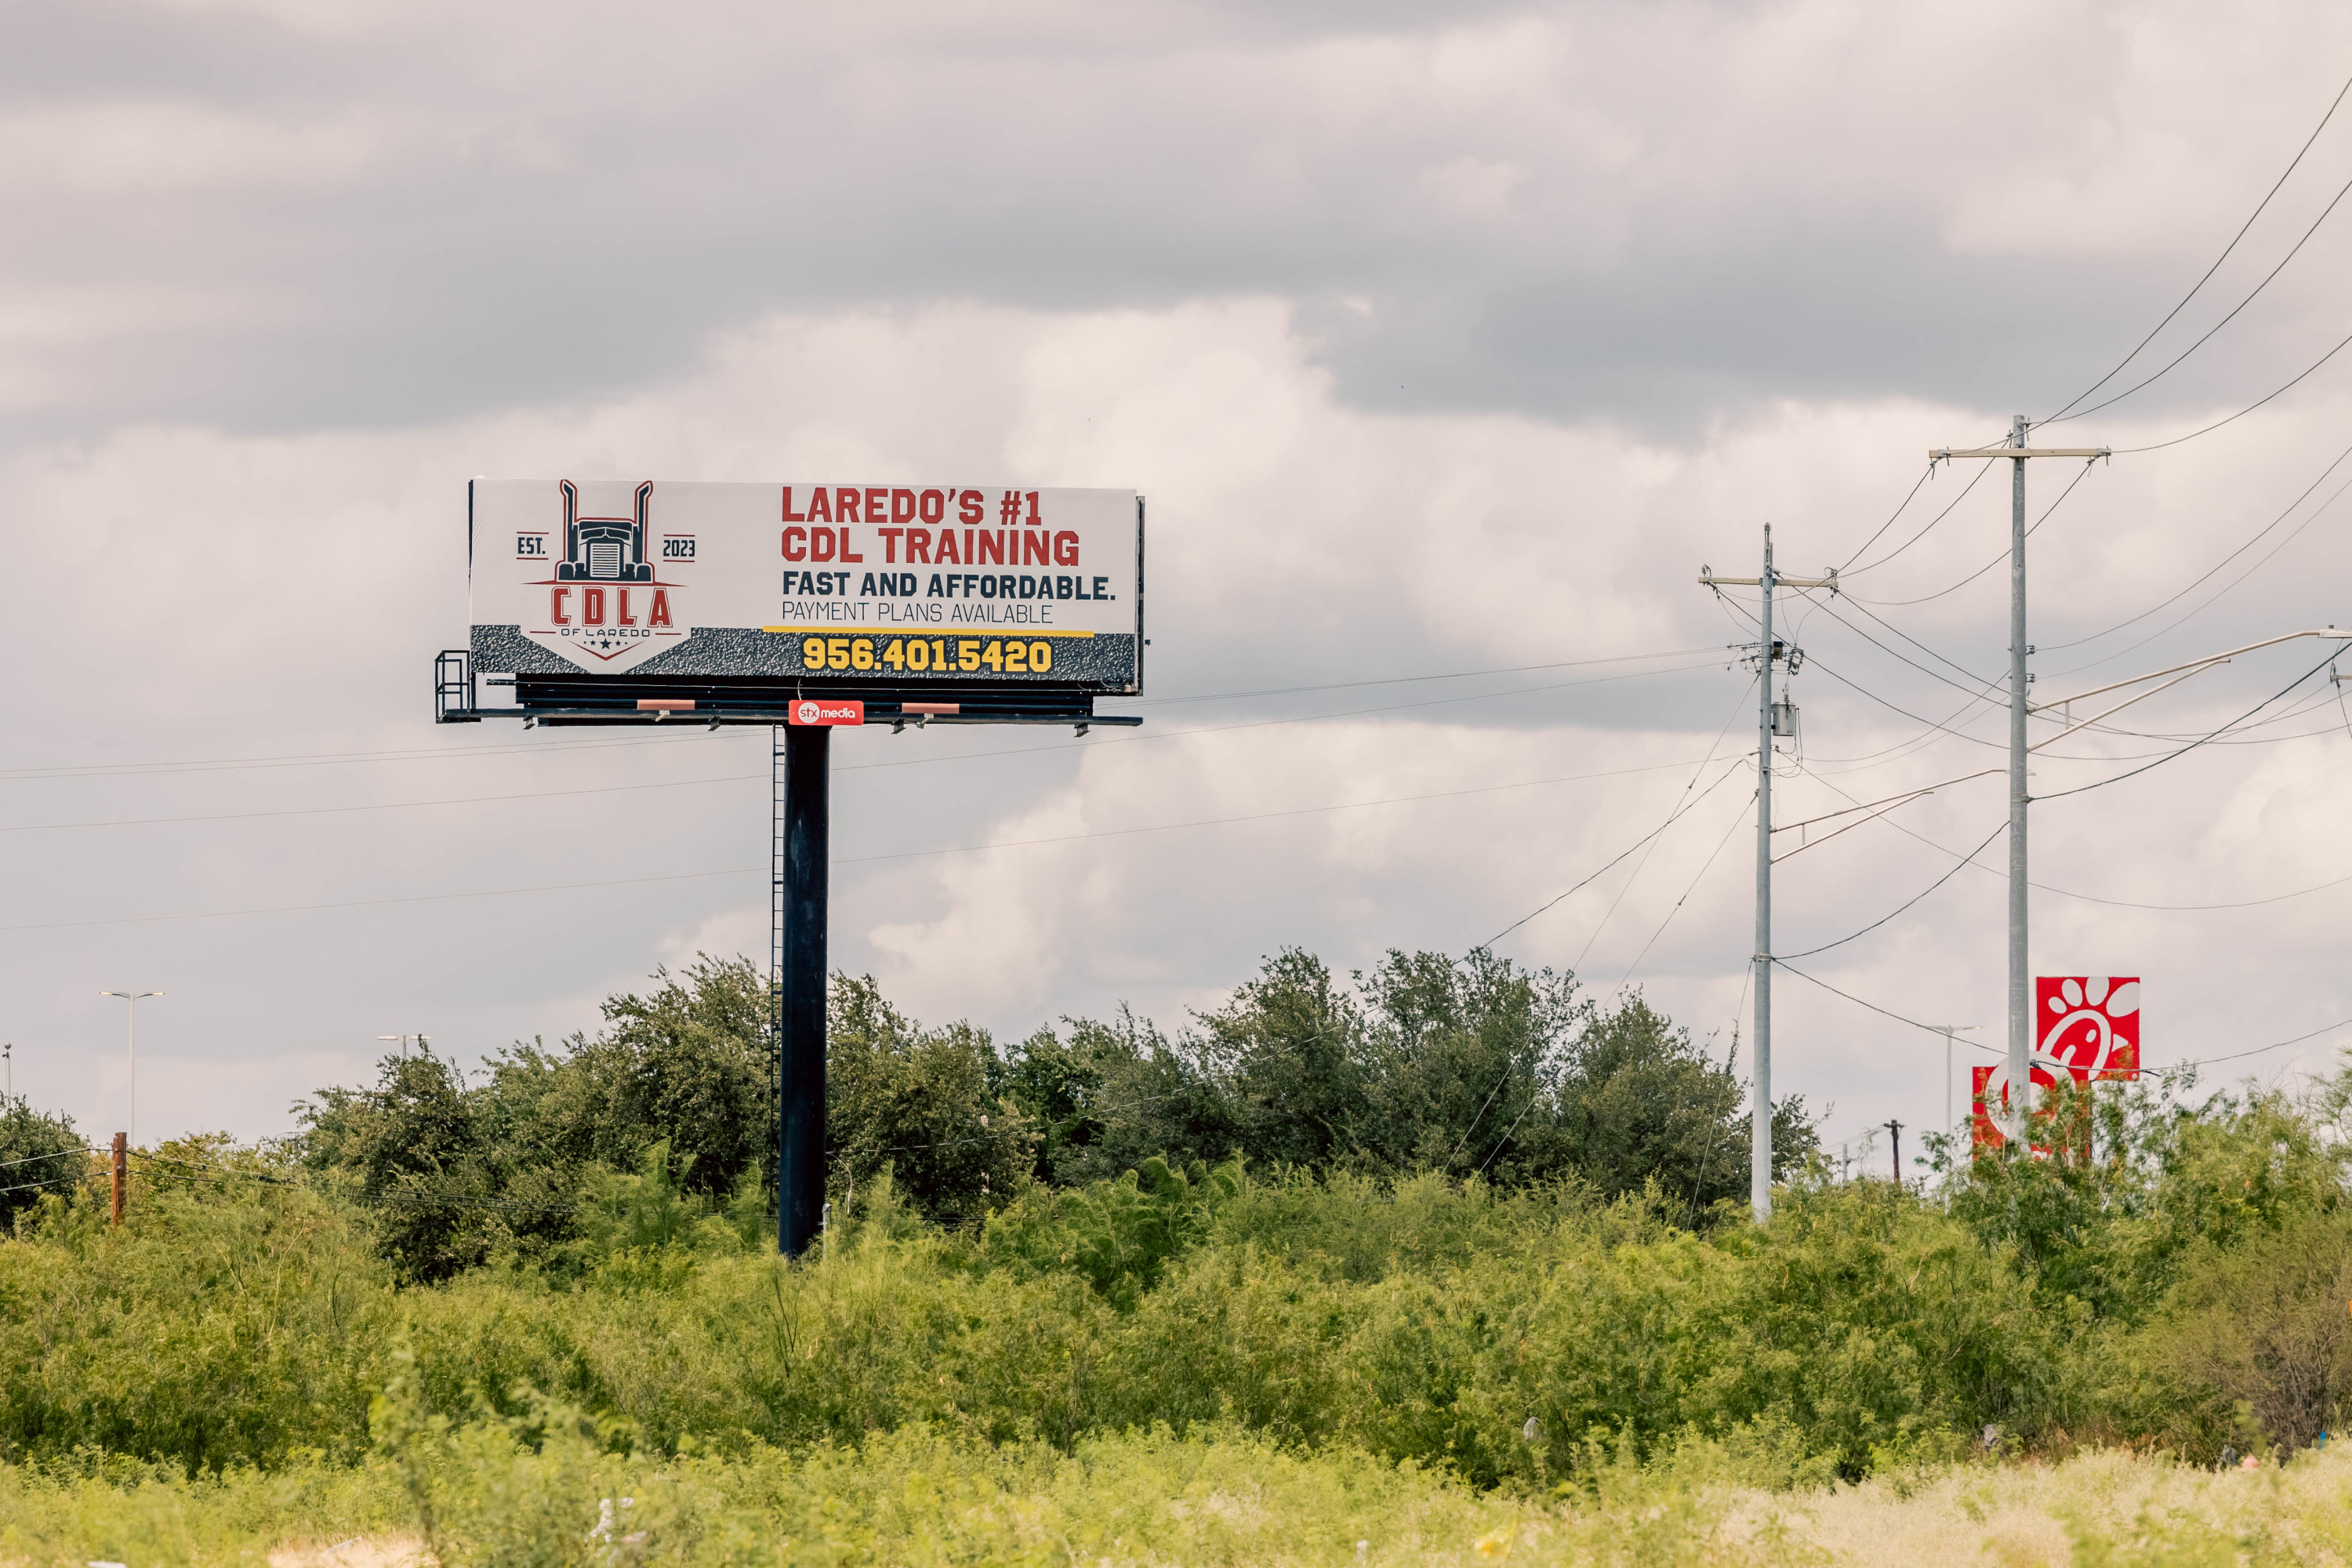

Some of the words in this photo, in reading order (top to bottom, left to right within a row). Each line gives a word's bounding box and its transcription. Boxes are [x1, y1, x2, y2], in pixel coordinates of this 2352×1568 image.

[782, 486, 984, 524] LAREDO'S
[1000, 490, 1042, 525] #1
[517, 537, 546, 555] EST.
[662, 539, 695, 557] 2023
[781, 526, 863, 564] CDL
[878, 528, 1080, 566] TRAINING
[783, 571, 851, 596] FAST
[859, 572, 917, 597] AND
[927, 574, 1116, 601] AFFORDABLE.
[551, 586, 673, 627] CDLA
[782, 601, 869, 620] PAYMENT
[878, 603, 942, 622] PLANS
[951, 604, 1053, 623] AVAILABLE
[561, 628, 581, 637] OF
[586, 628, 651, 637] LAREDO
[803, 638, 1052, 673] 956.401.5420
[800, 707, 818, 717] stx
[820, 707, 856, 718] media
